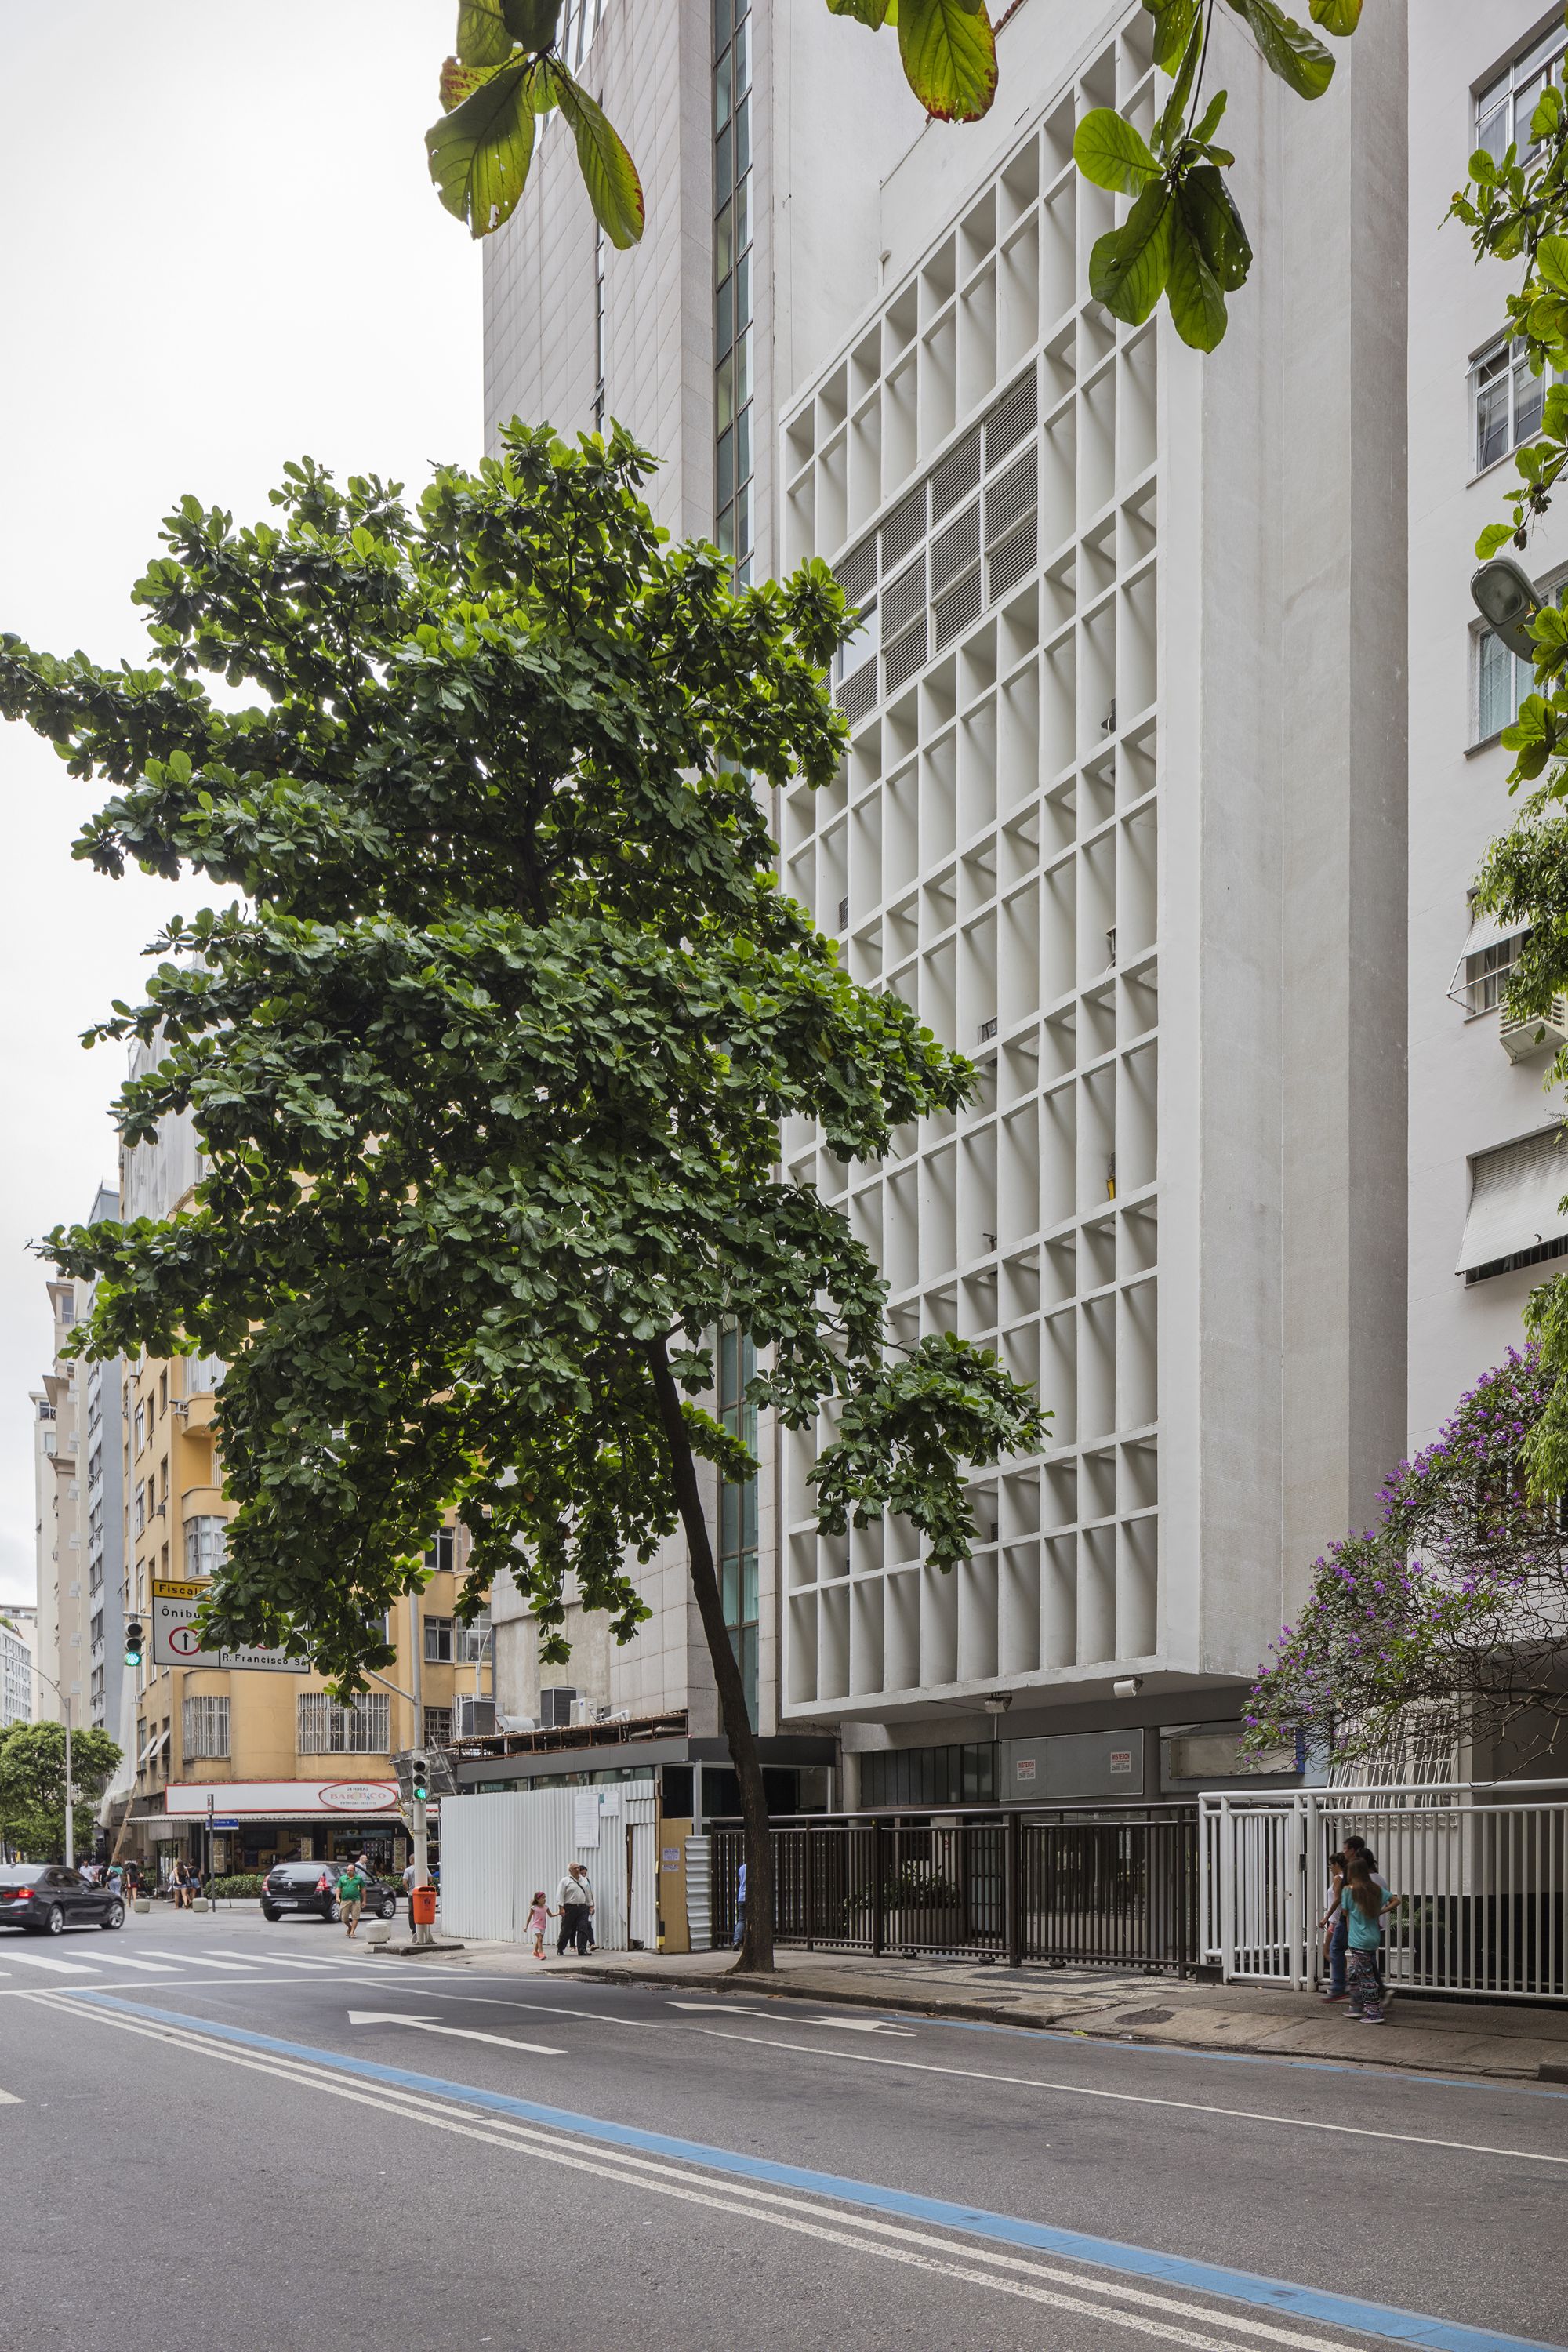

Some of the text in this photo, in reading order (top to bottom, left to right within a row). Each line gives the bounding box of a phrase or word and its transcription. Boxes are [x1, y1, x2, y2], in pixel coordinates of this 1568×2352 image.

[159, 1584, 204, 1595] Fiscali
[162, 1605, 202, 1619] Ônibu
[223, 1653, 307, 1667] R. Francisco Sá
